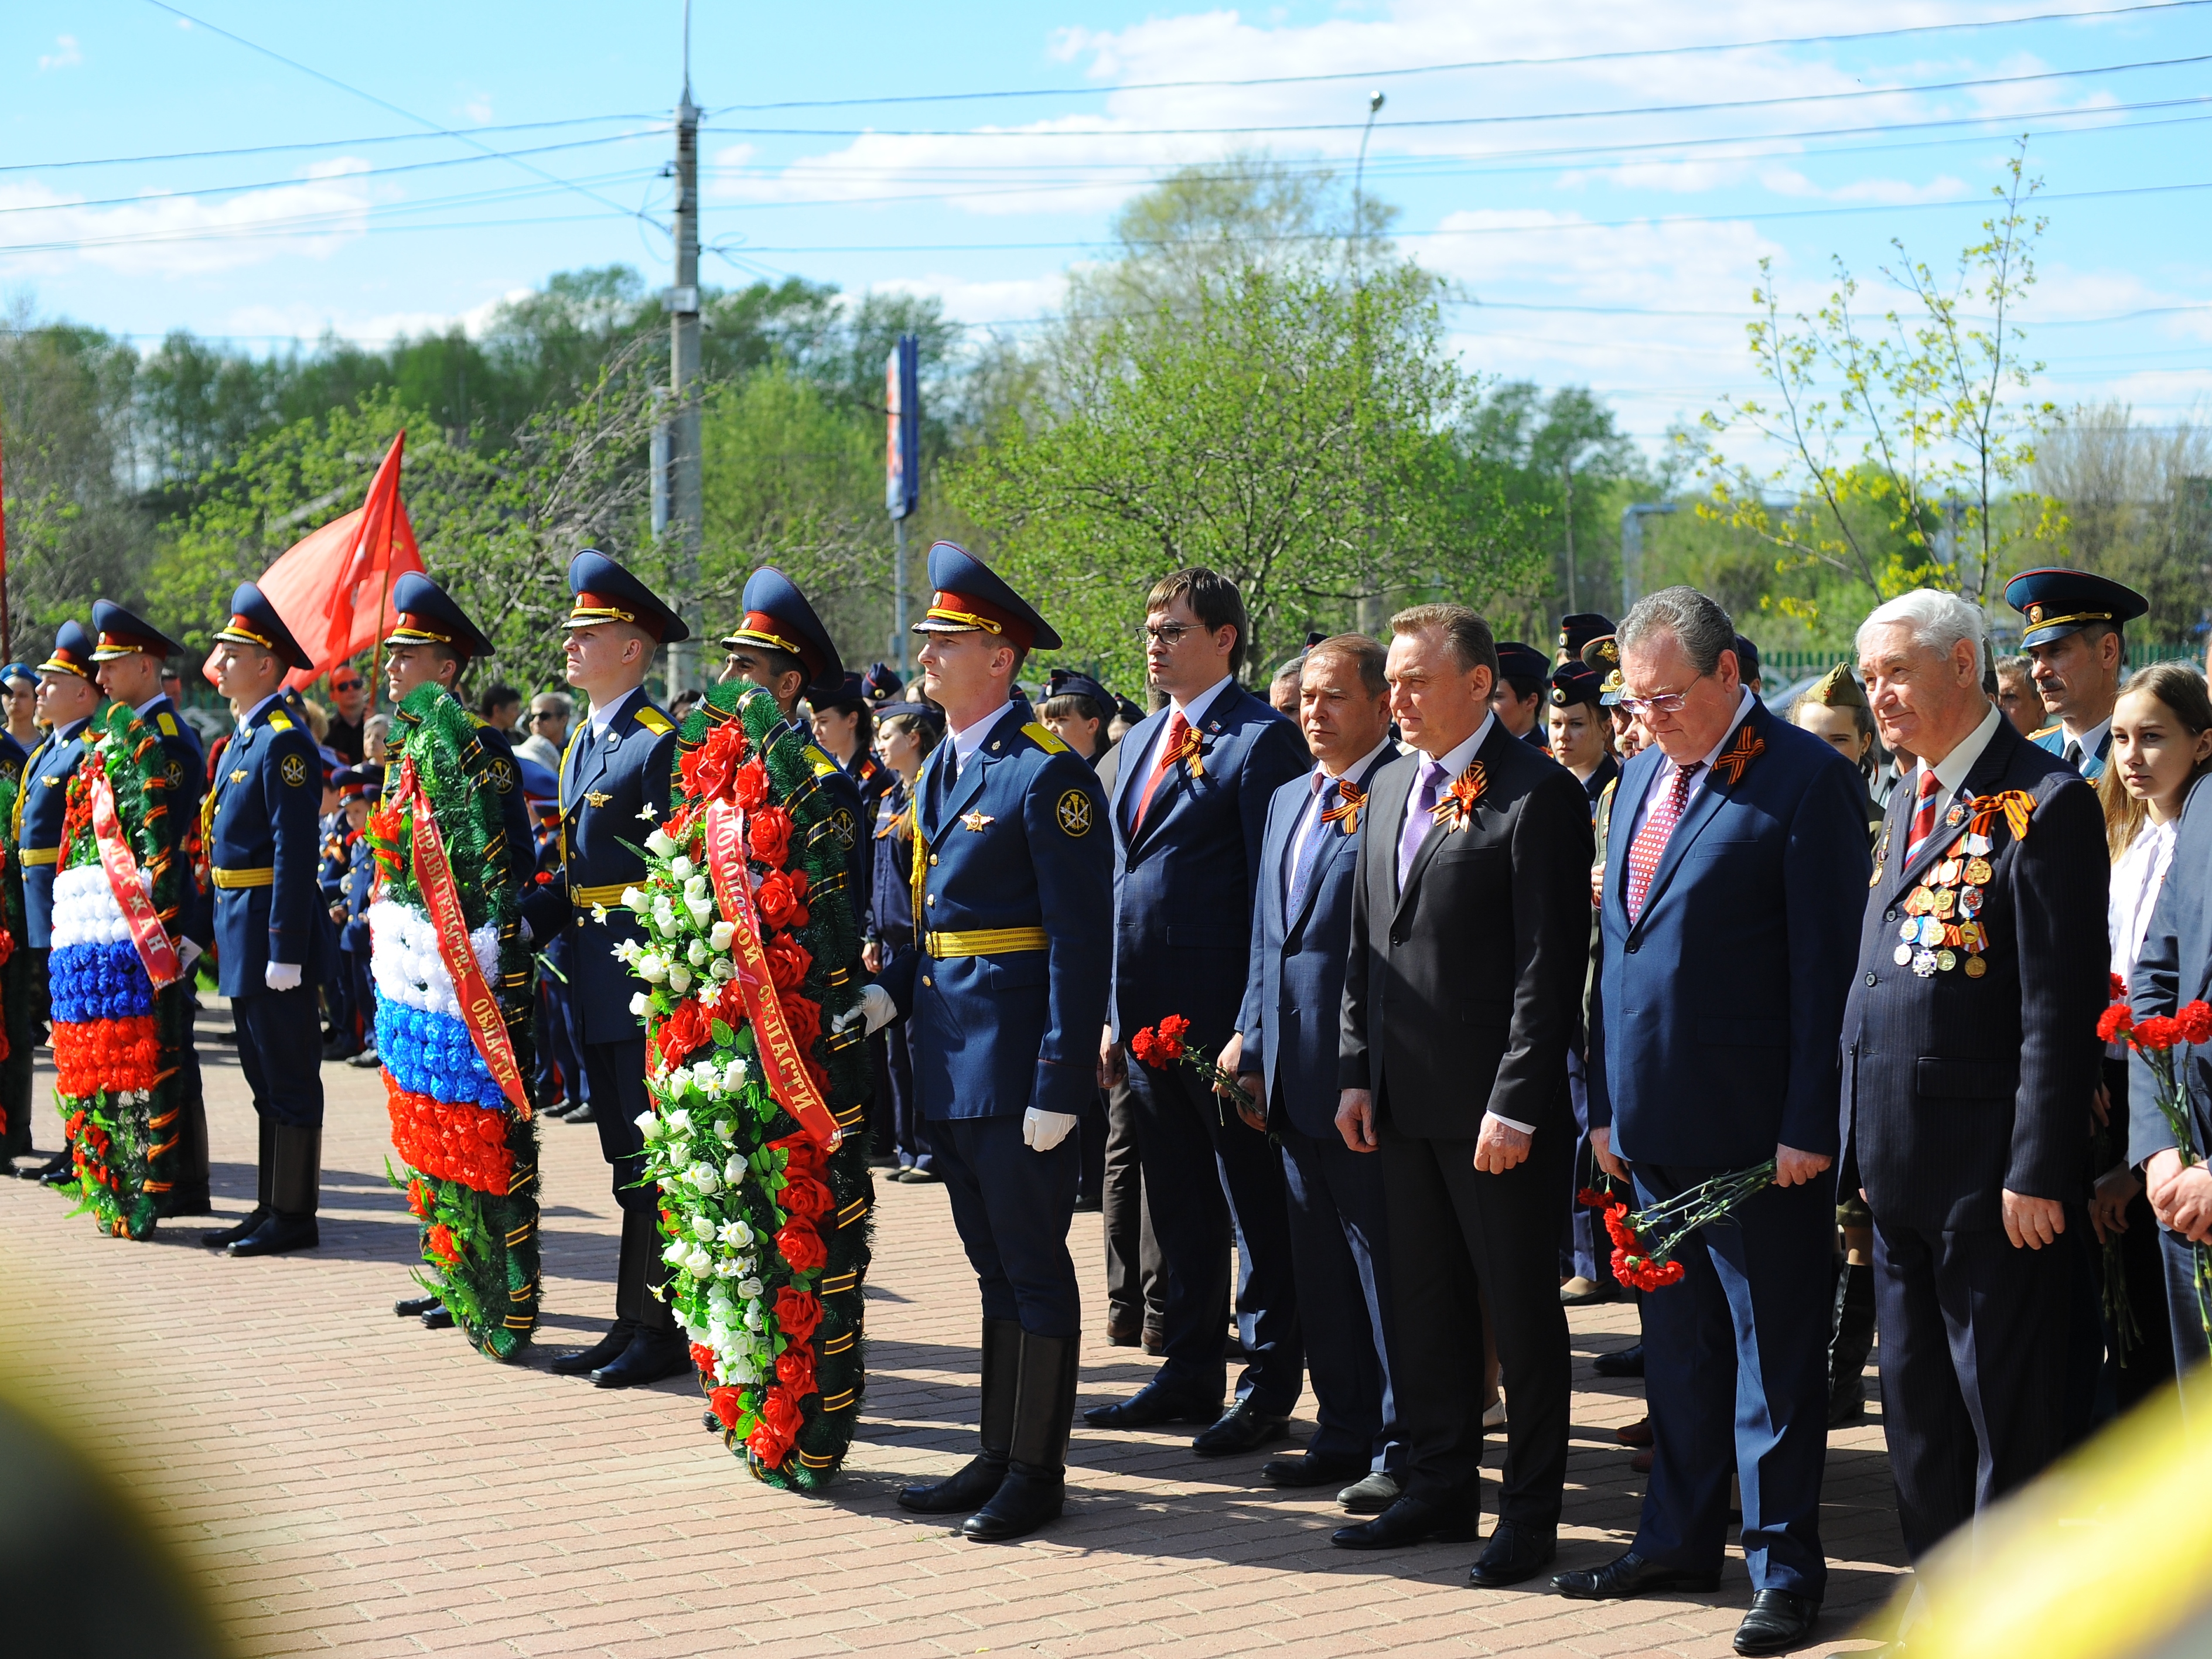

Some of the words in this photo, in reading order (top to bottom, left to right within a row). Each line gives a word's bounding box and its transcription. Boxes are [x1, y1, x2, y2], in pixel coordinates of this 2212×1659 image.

[415, 823, 474, 982] ПРАВИТЕЛЬСТВА
[471, 998, 516, 1087] ОБЛАСТИ
[757, 985, 818, 1114] ОБЛАСТИ
